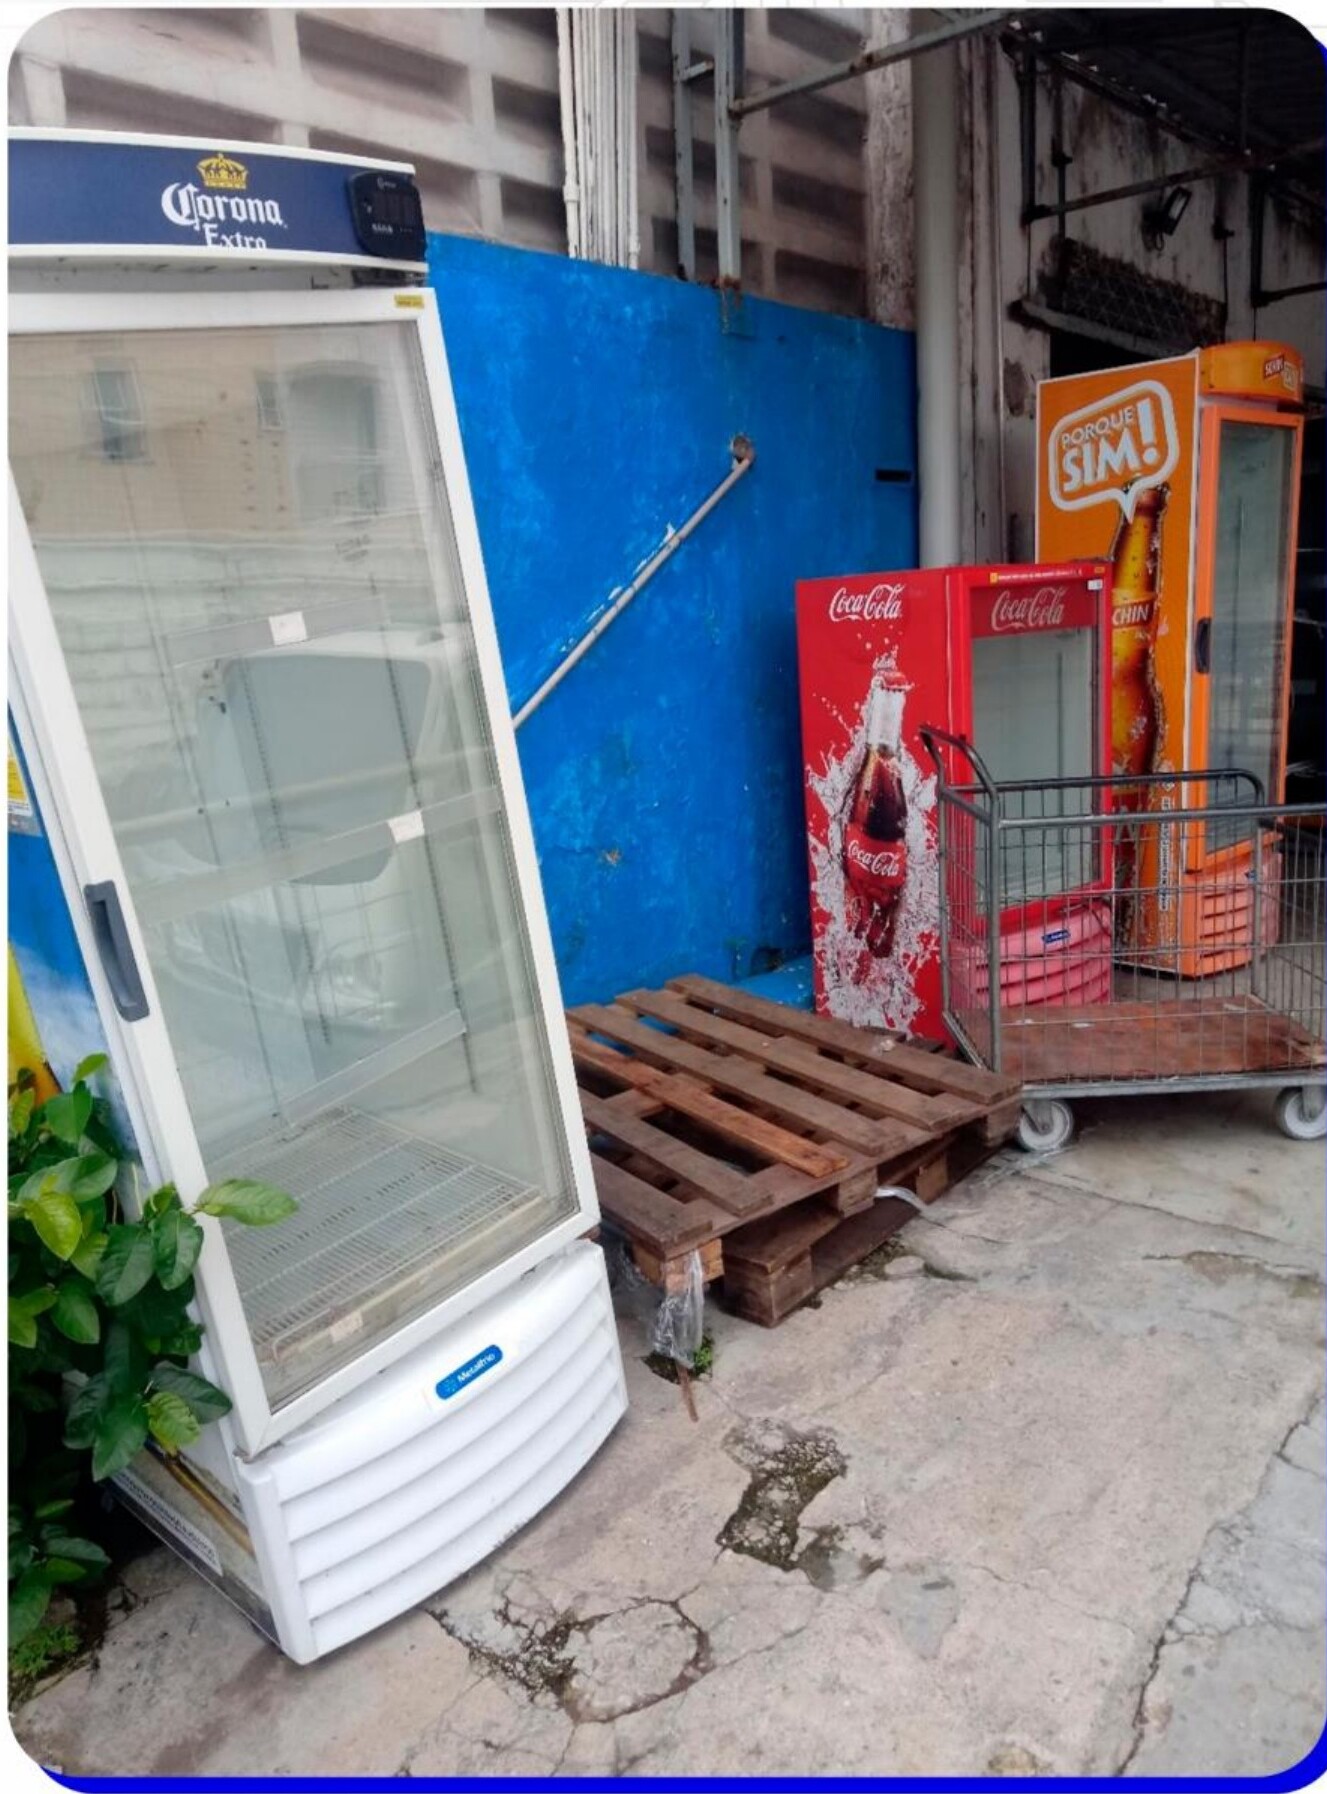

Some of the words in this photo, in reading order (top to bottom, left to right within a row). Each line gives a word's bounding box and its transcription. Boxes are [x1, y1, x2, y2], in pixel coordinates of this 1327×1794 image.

[161, 182, 283, 231] Corona
[203, 222, 267, 250] Extra
[1061, 405, 1134, 450] PORQUE
[1063, 398, 1159, 493] SIM!
[829, 583, 906, 622] Coca-Cola
[991, 586, 1066, 631] Coca-Cola
[848, 839, 901, 877] Coca-Cola
